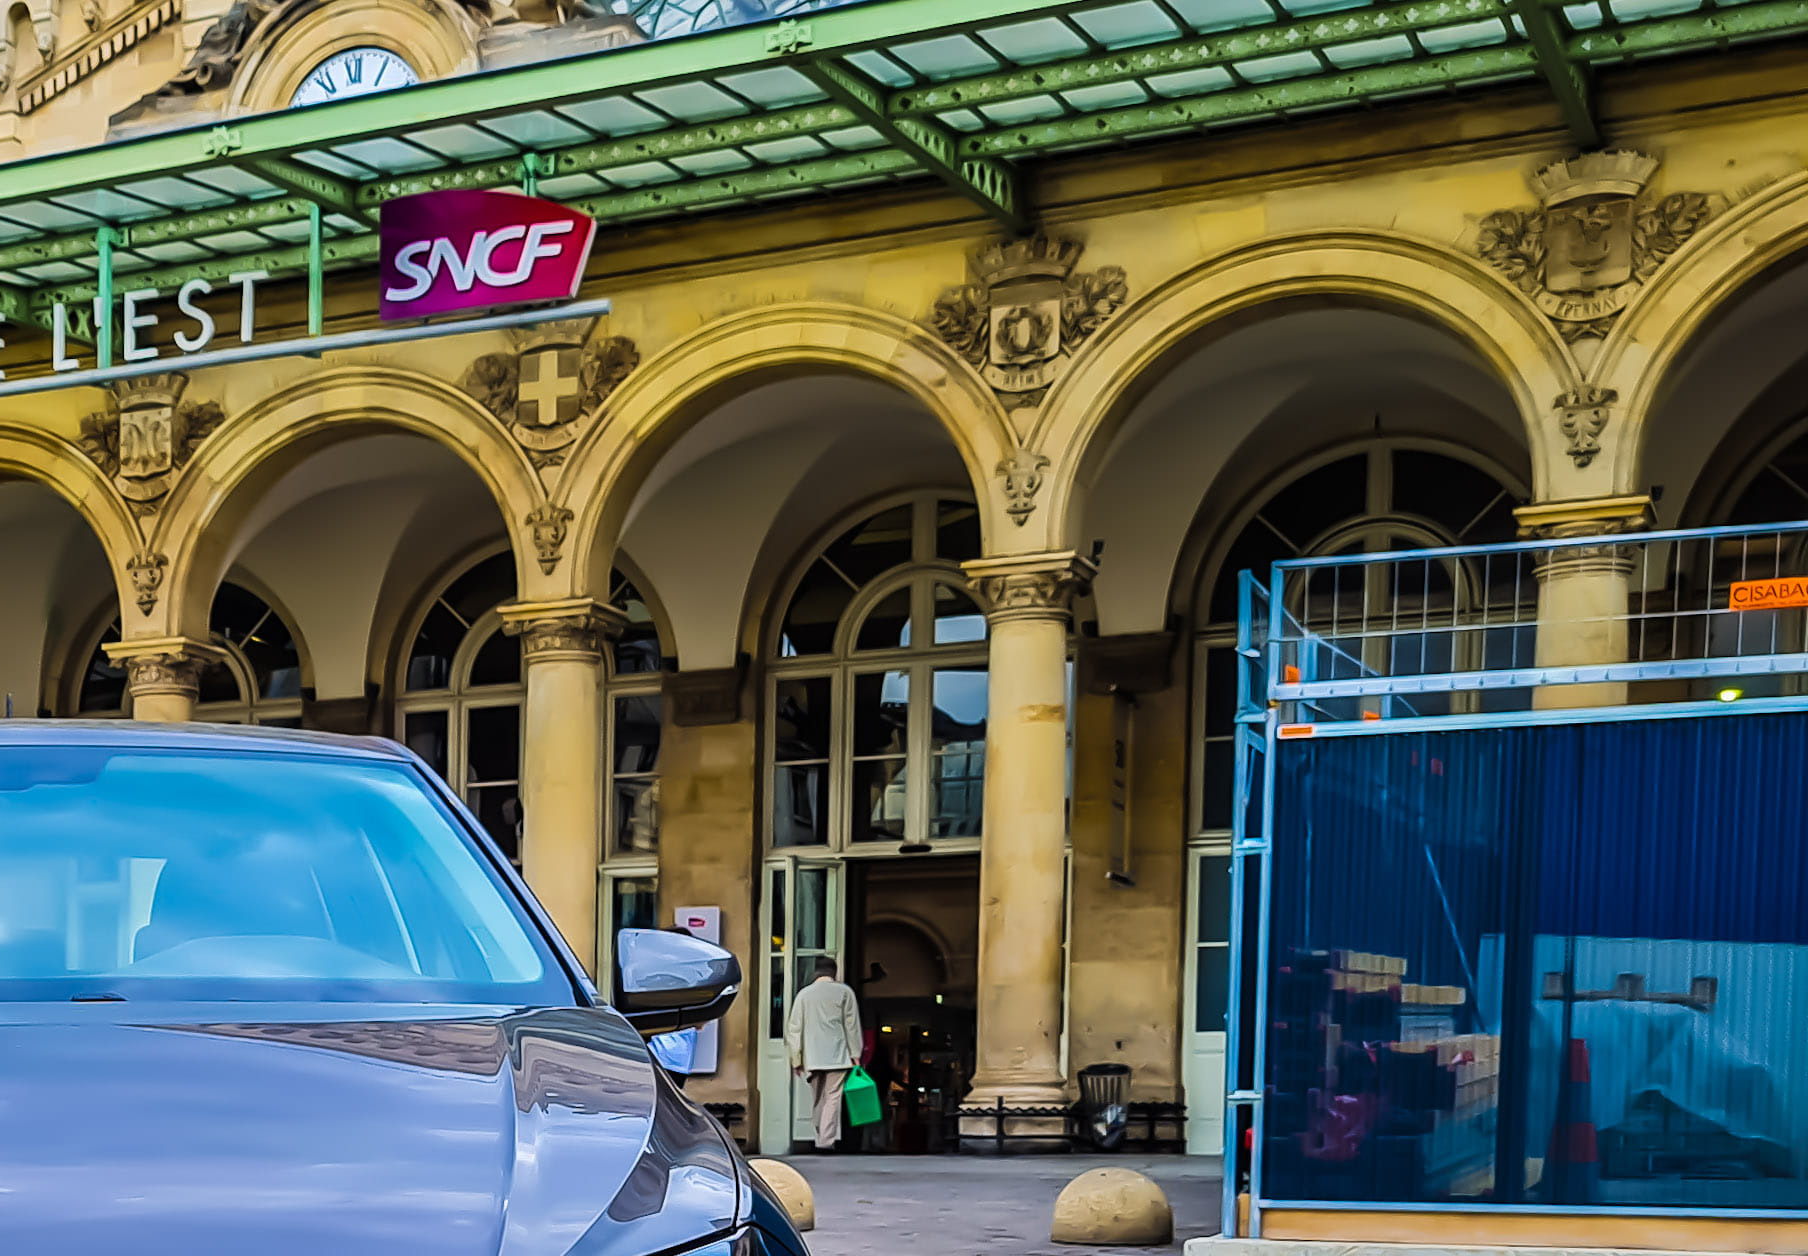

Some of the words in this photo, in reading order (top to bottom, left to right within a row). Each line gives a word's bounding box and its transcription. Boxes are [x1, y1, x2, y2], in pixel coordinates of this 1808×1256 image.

[385, 219, 574, 302] SNCF
[52, 270, 270, 371] L'EST
[1733, 582, 1808, 602] CISABA
